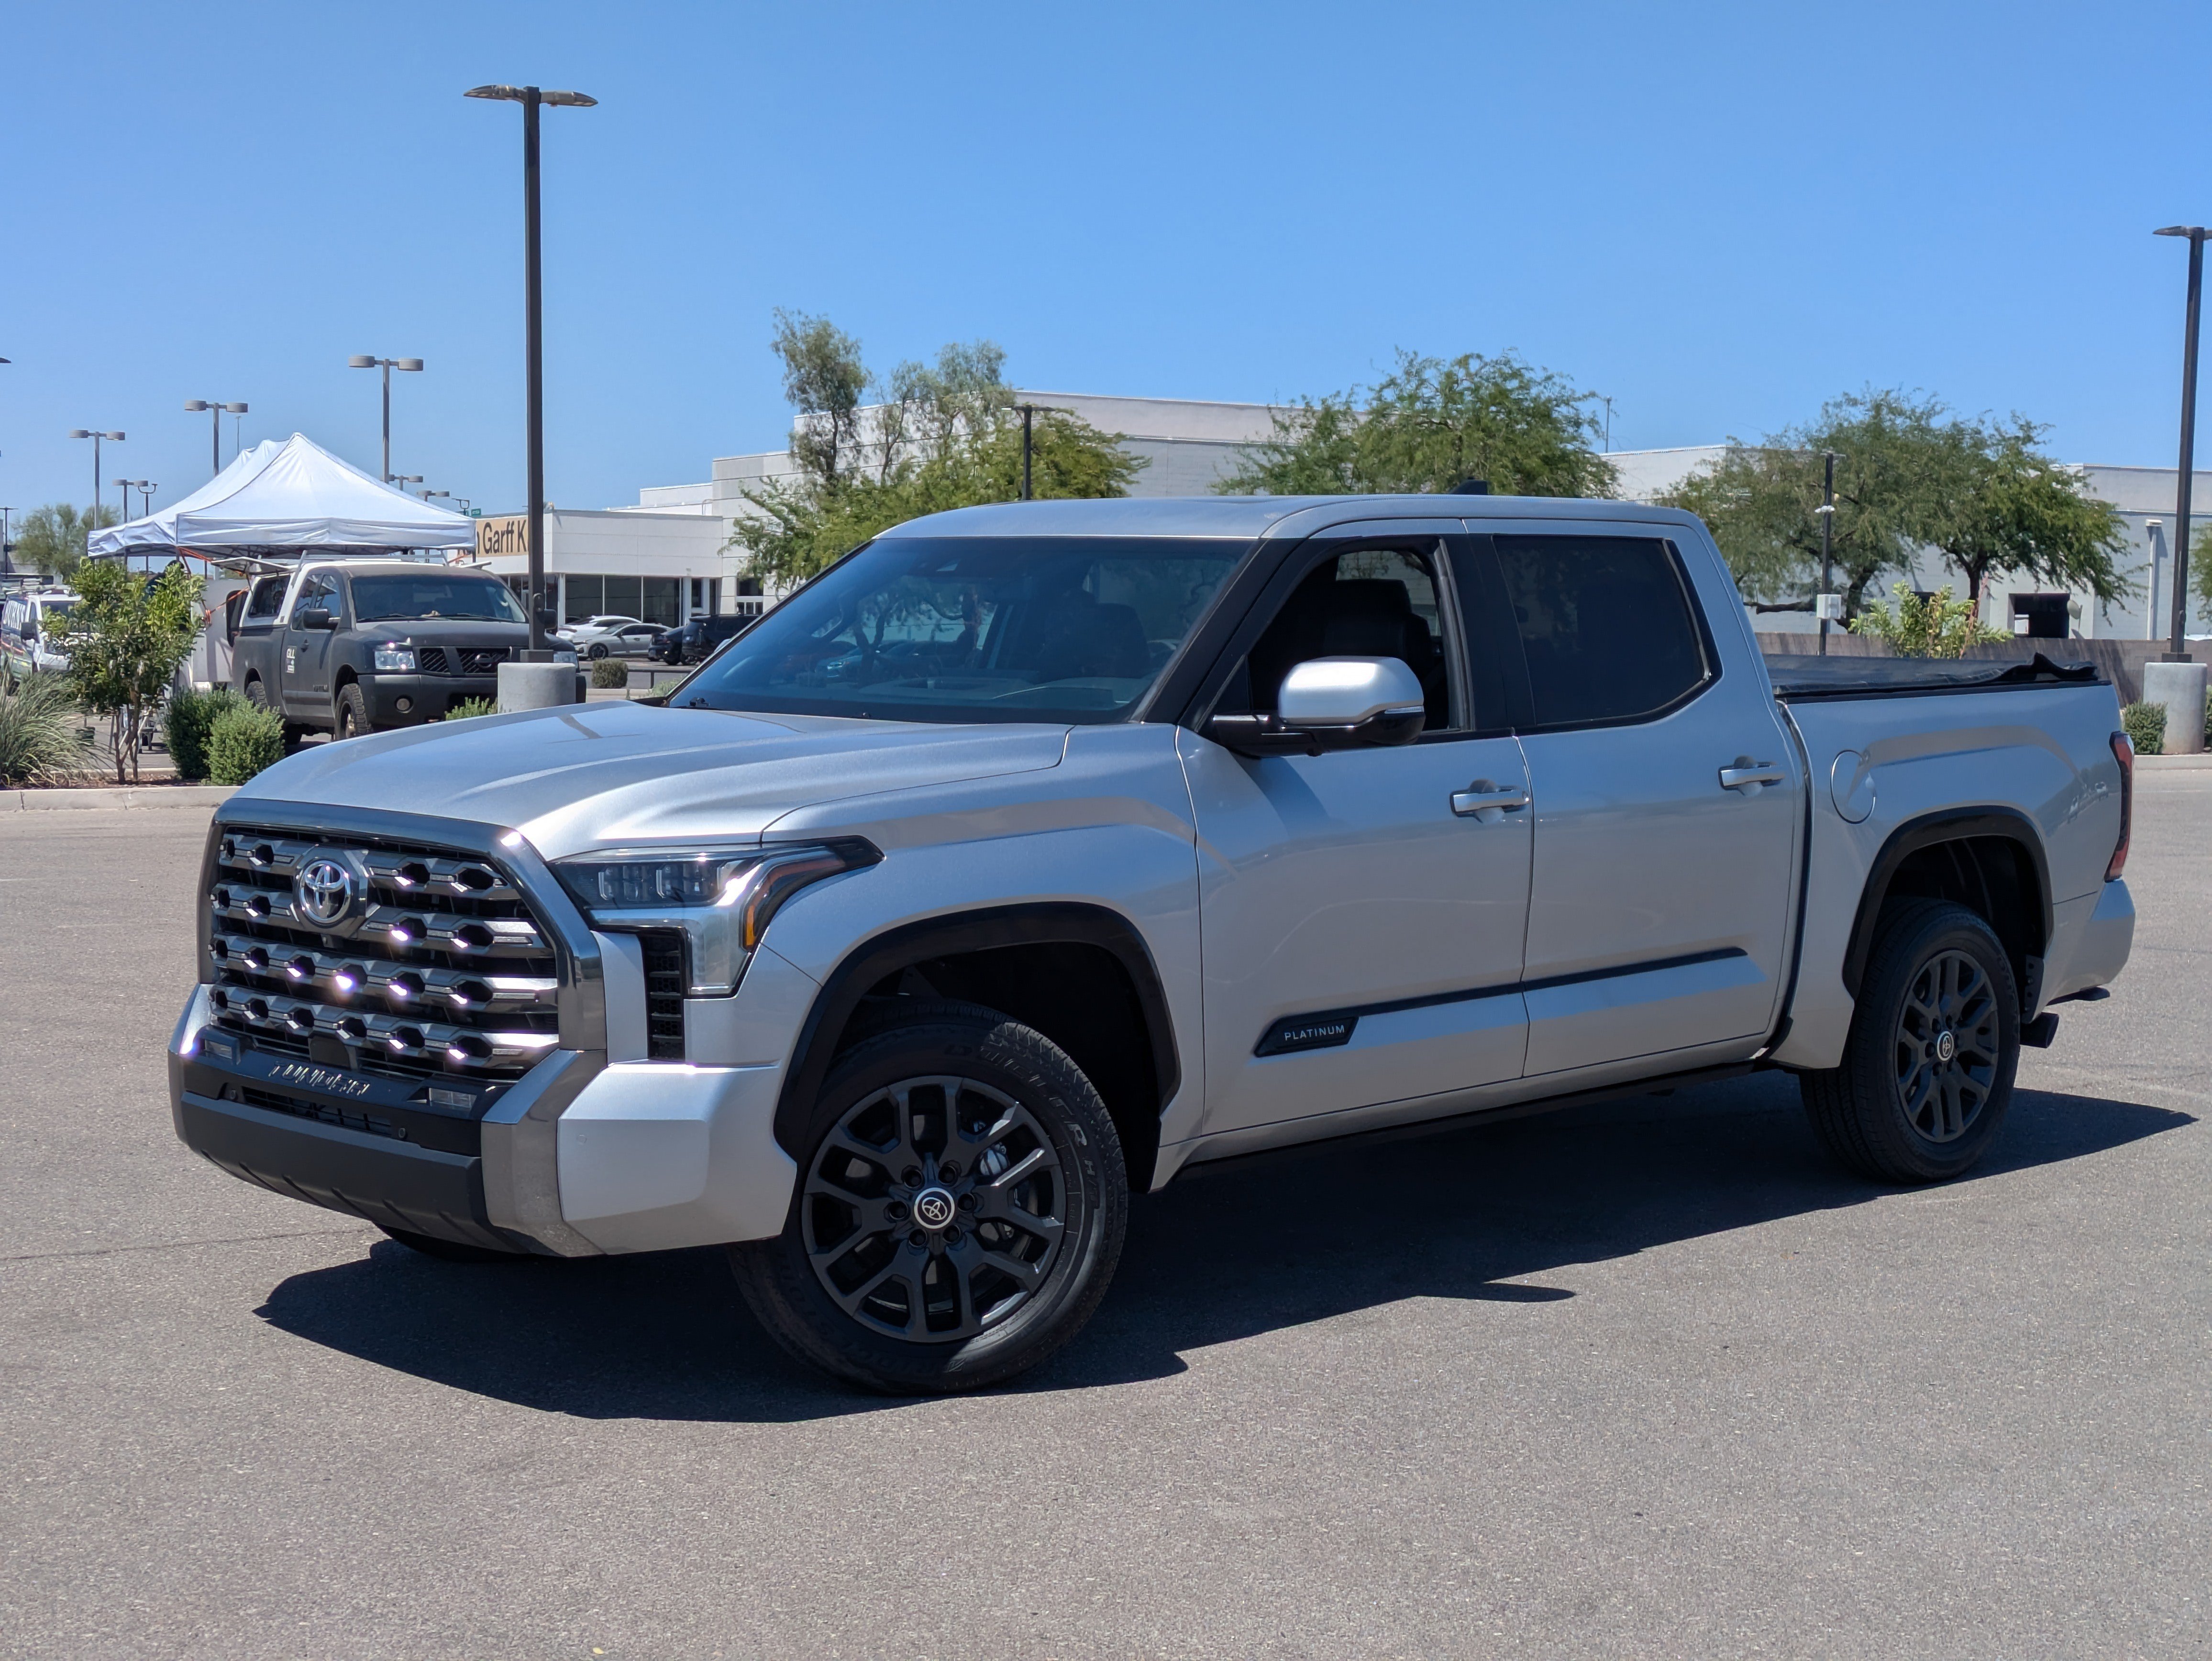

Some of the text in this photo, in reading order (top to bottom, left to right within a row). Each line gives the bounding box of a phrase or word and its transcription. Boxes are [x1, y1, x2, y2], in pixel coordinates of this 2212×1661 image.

[483, 520, 515, 554] Garff
[3, 600, 26, 630] BURNS
[1284, 1024, 1345, 1041] PLATINUM
